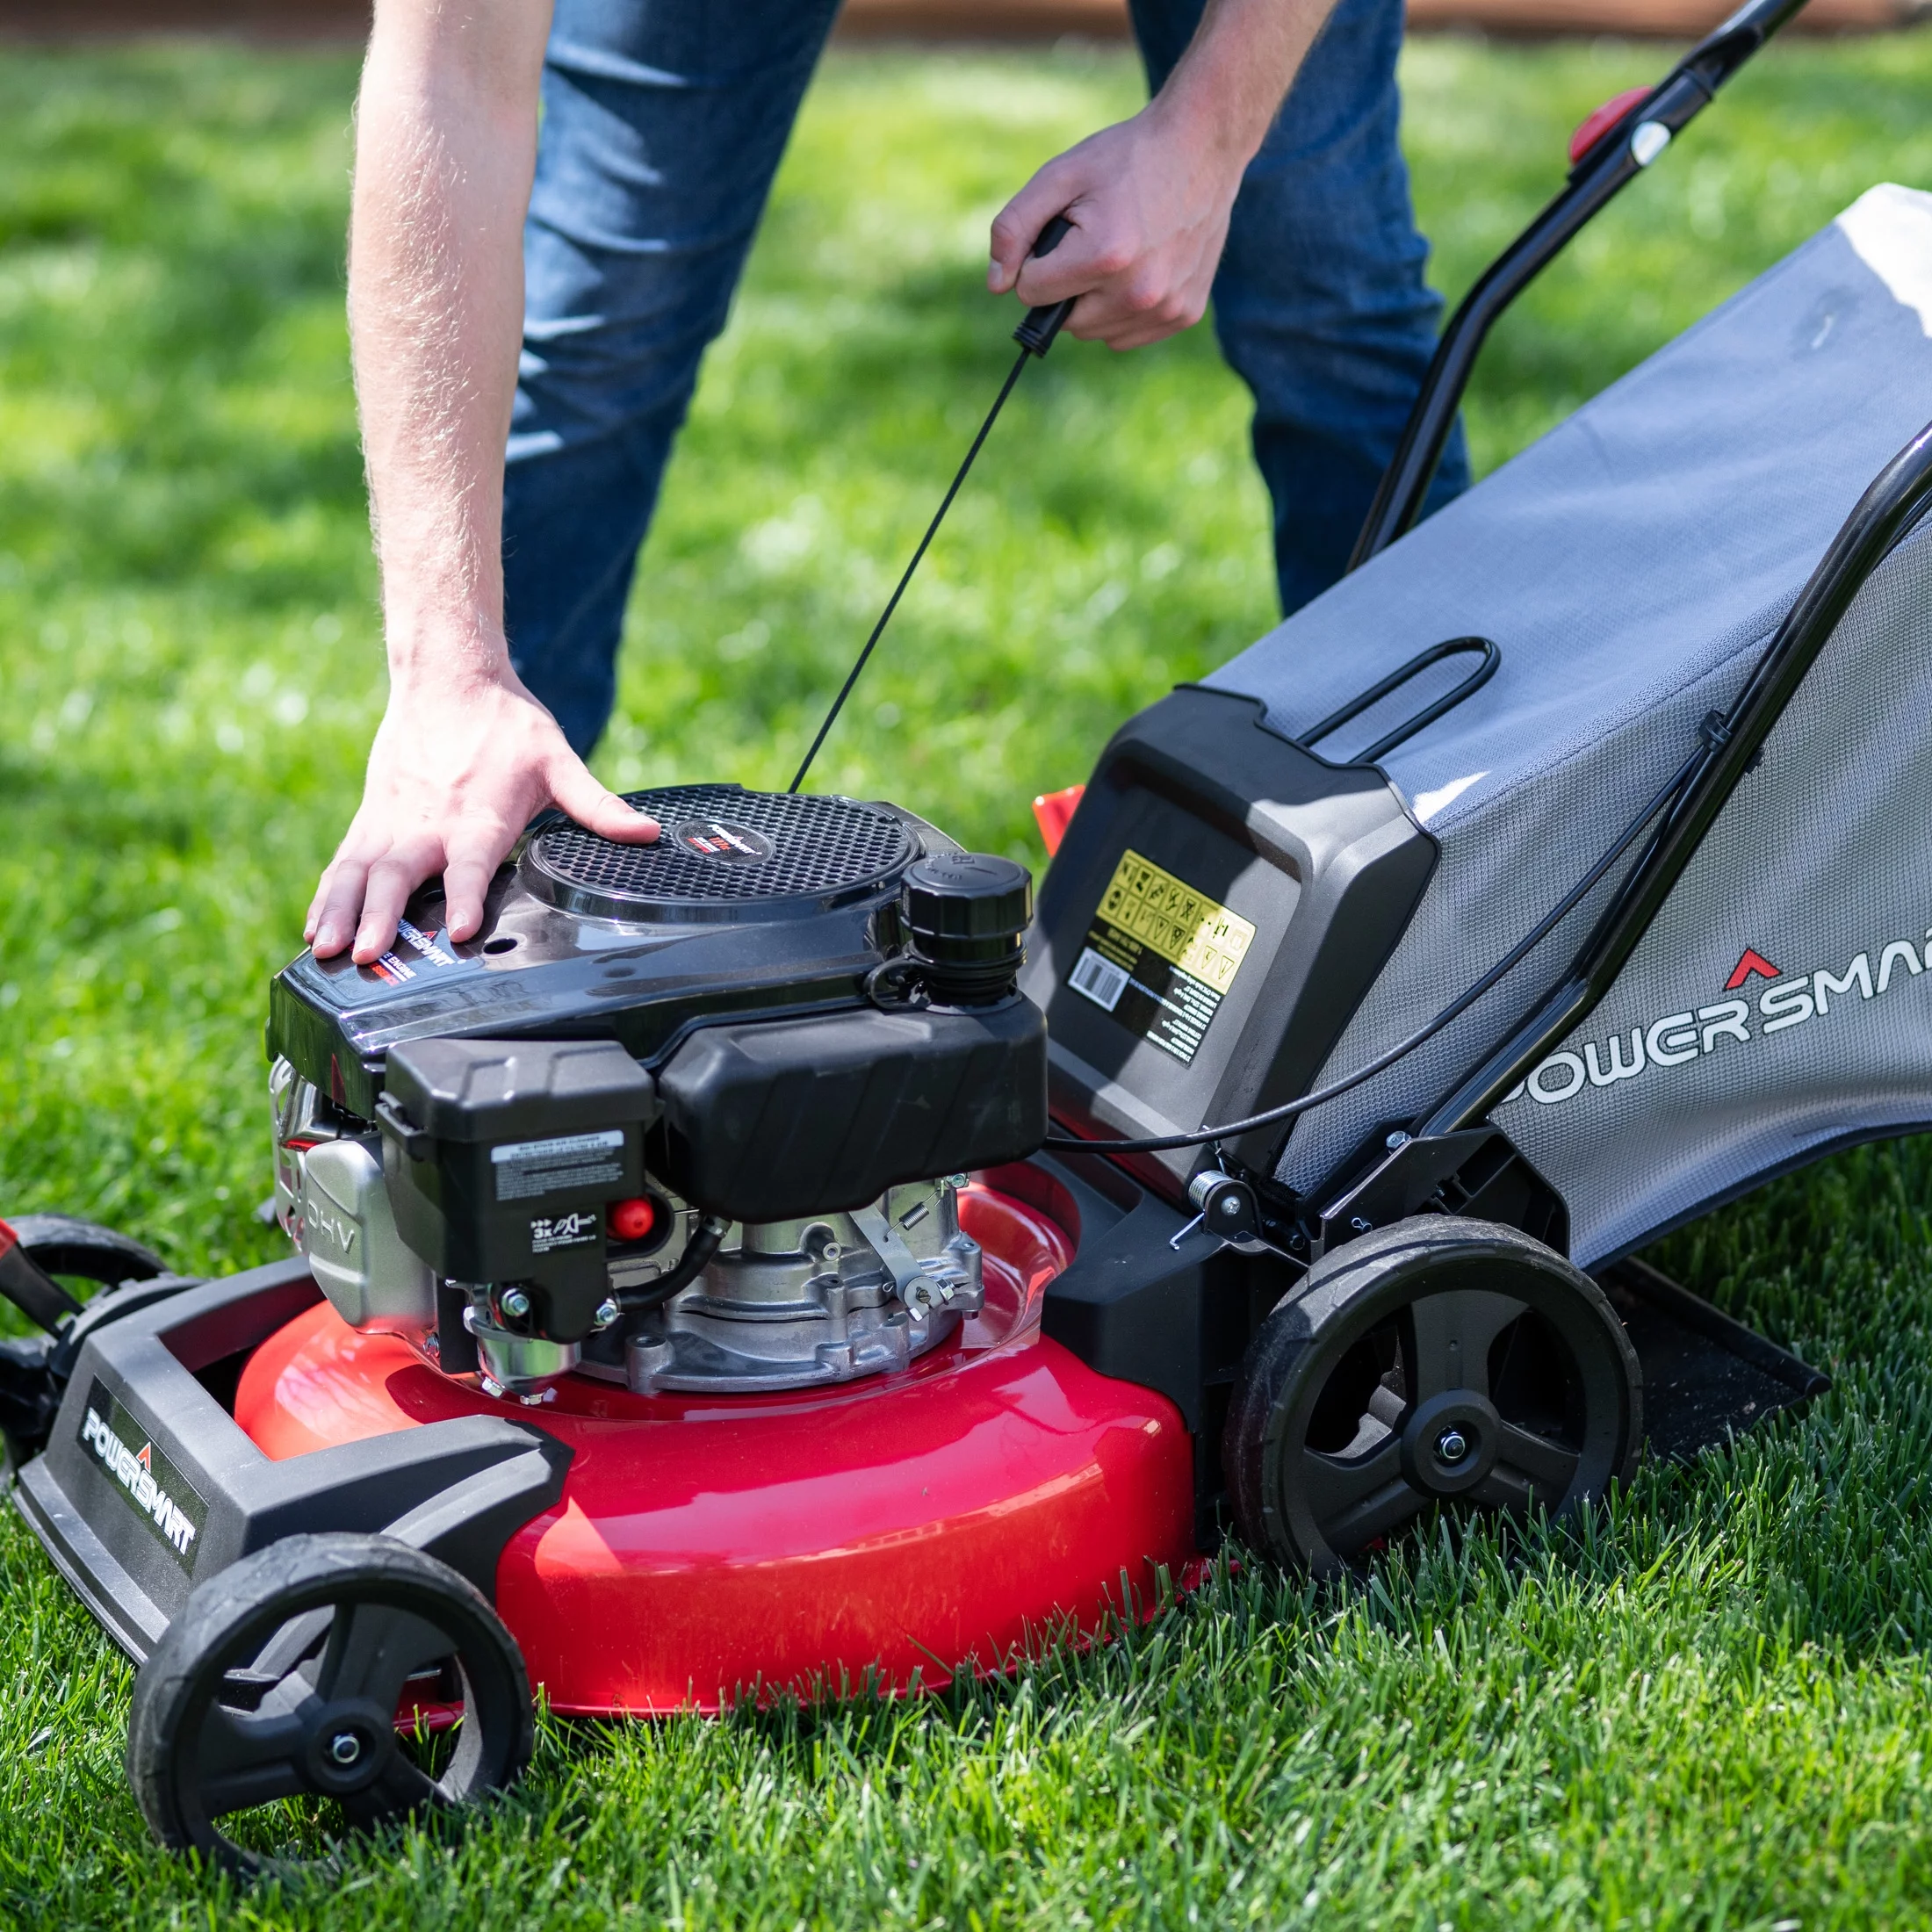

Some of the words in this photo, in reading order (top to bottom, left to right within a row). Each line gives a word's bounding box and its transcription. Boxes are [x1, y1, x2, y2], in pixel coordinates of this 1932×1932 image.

[1501, 928, 1932, 1105] OWERSMA
[308, 1199, 355, 1254] OHV
[533, 1228, 552, 1239] 3x
[83, 1407, 196, 1555] POWERSMART
